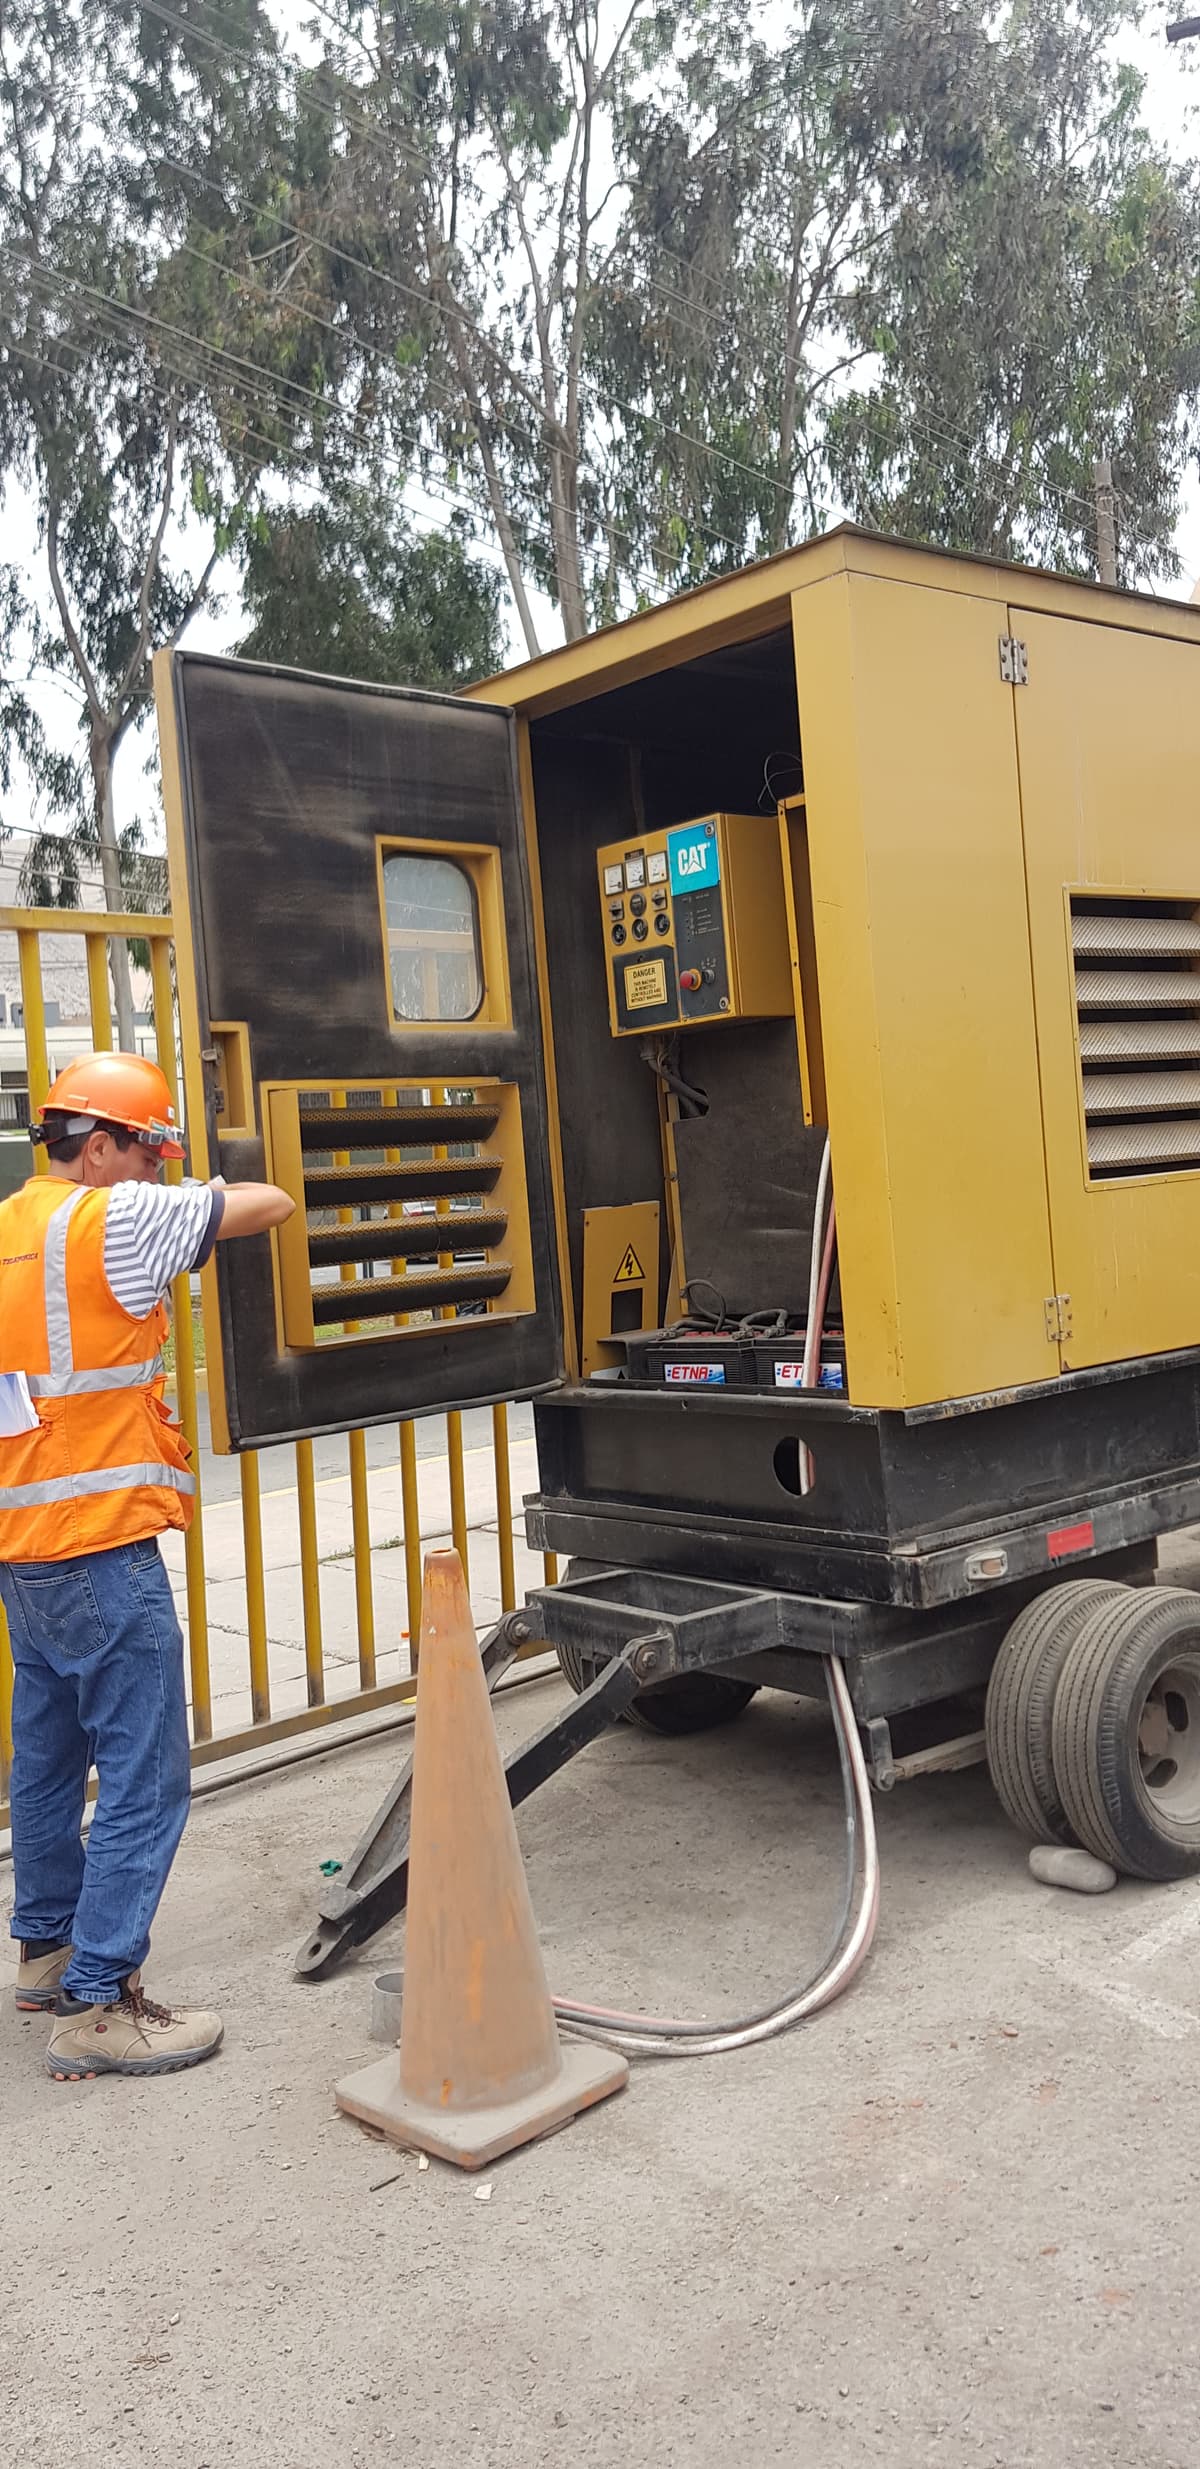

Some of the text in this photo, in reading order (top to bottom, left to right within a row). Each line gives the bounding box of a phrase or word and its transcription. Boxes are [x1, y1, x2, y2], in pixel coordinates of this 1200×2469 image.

[677, 842, 707, 876] CAT
[633, 967, 656, 979] DANGER
[671, 1366, 709, 1380] ETNA
